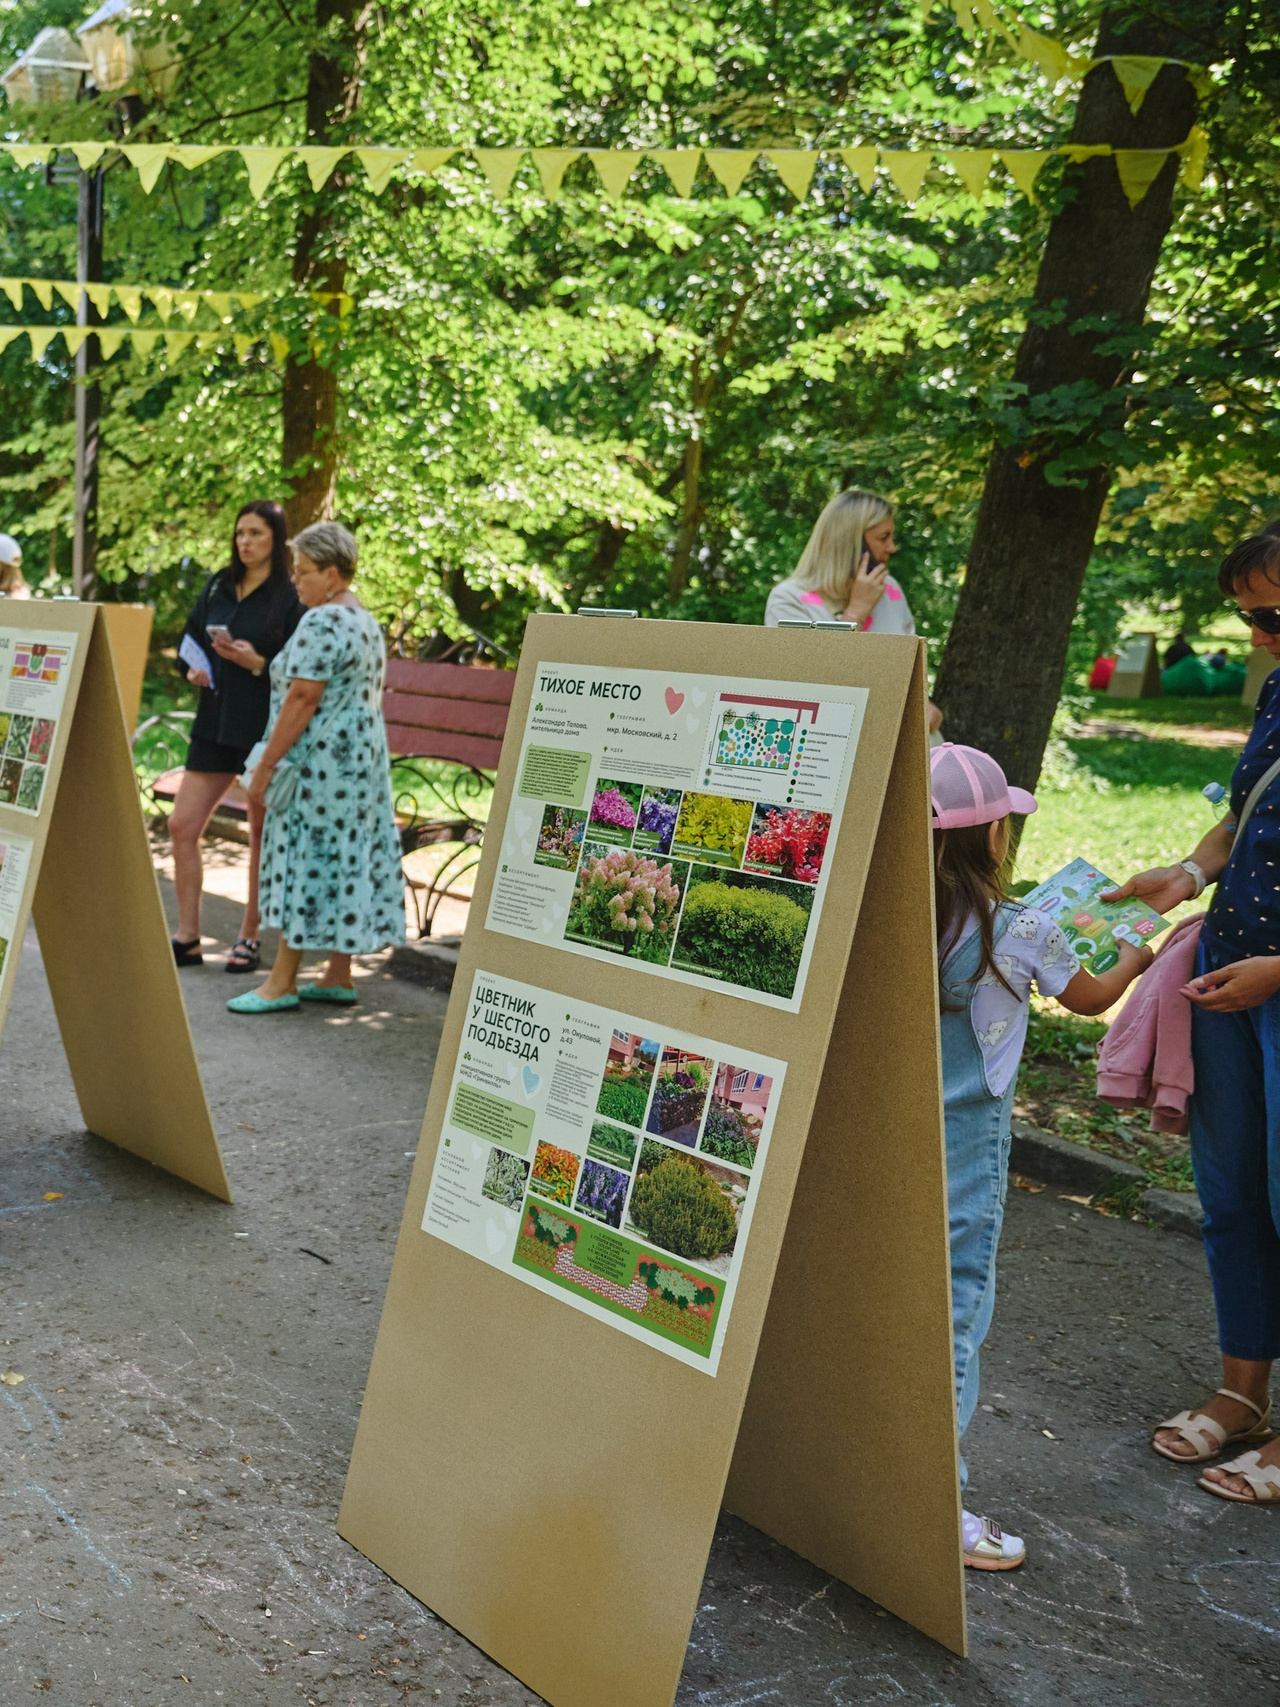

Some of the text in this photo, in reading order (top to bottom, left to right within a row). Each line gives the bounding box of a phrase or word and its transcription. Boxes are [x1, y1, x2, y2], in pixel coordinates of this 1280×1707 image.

[539, 676, 642, 701] ТИХОЕ МЕСТО
[530, 724, 579, 736] жительница дома
[531, 716, 566, 727] Александра
[606, 726, 620, 735] мкр.
[621, 727, 664, 739] Московский,
[475, 985, 537, 1019] ЦВЕТНИК
[472, 1004, 551, 1044] У ШЕСТОГО
[467, 1023, 540, 1063] ПОДЪЕЗДА
[559, 1034, 573, 1046] д.43
[561, 1026, 602, 1045] ул. Окуловой,
[460, 1062, 510, 1086] инициативная группа
